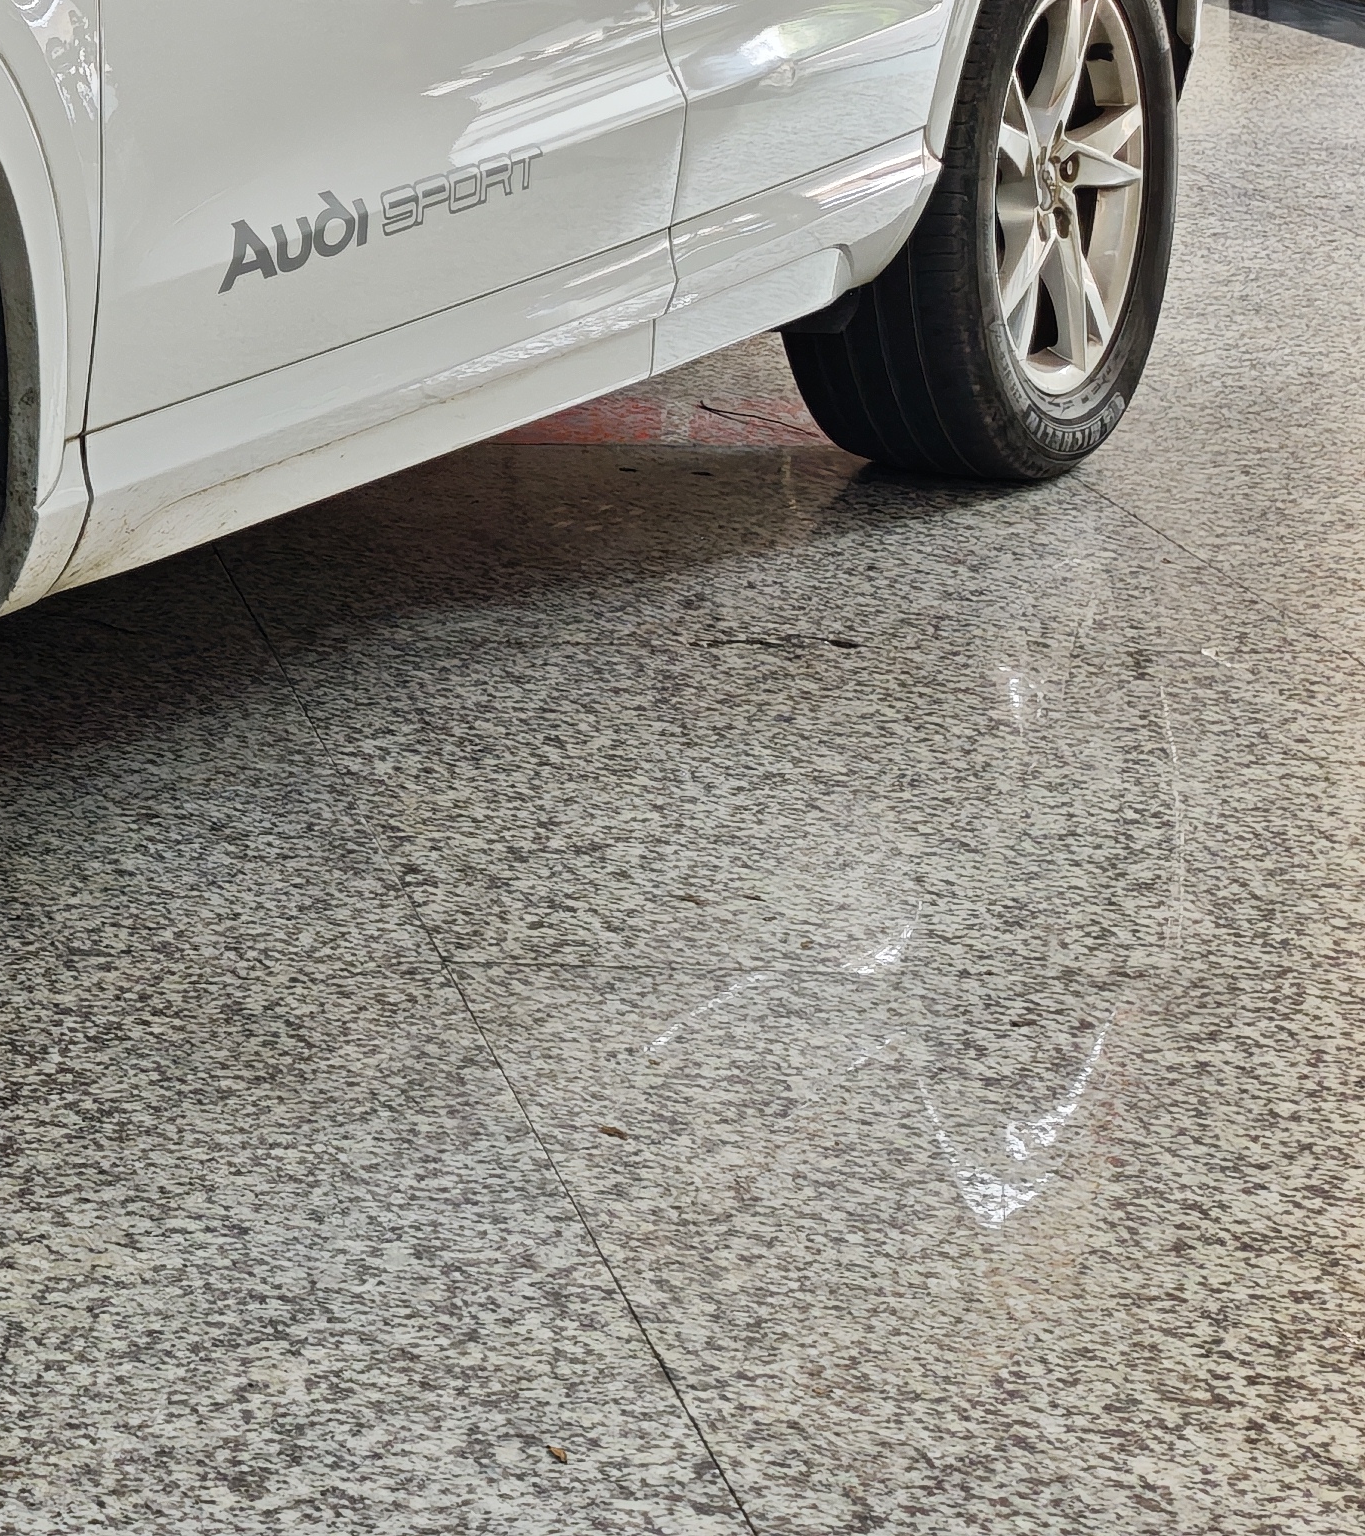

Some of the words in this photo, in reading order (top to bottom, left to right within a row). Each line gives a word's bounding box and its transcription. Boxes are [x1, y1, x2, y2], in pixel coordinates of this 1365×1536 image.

[218, 190, 368, 295] Audi
[380, 143, 543, 237] SPORT
[1025, 410, 1102, 452] MICHELIN
